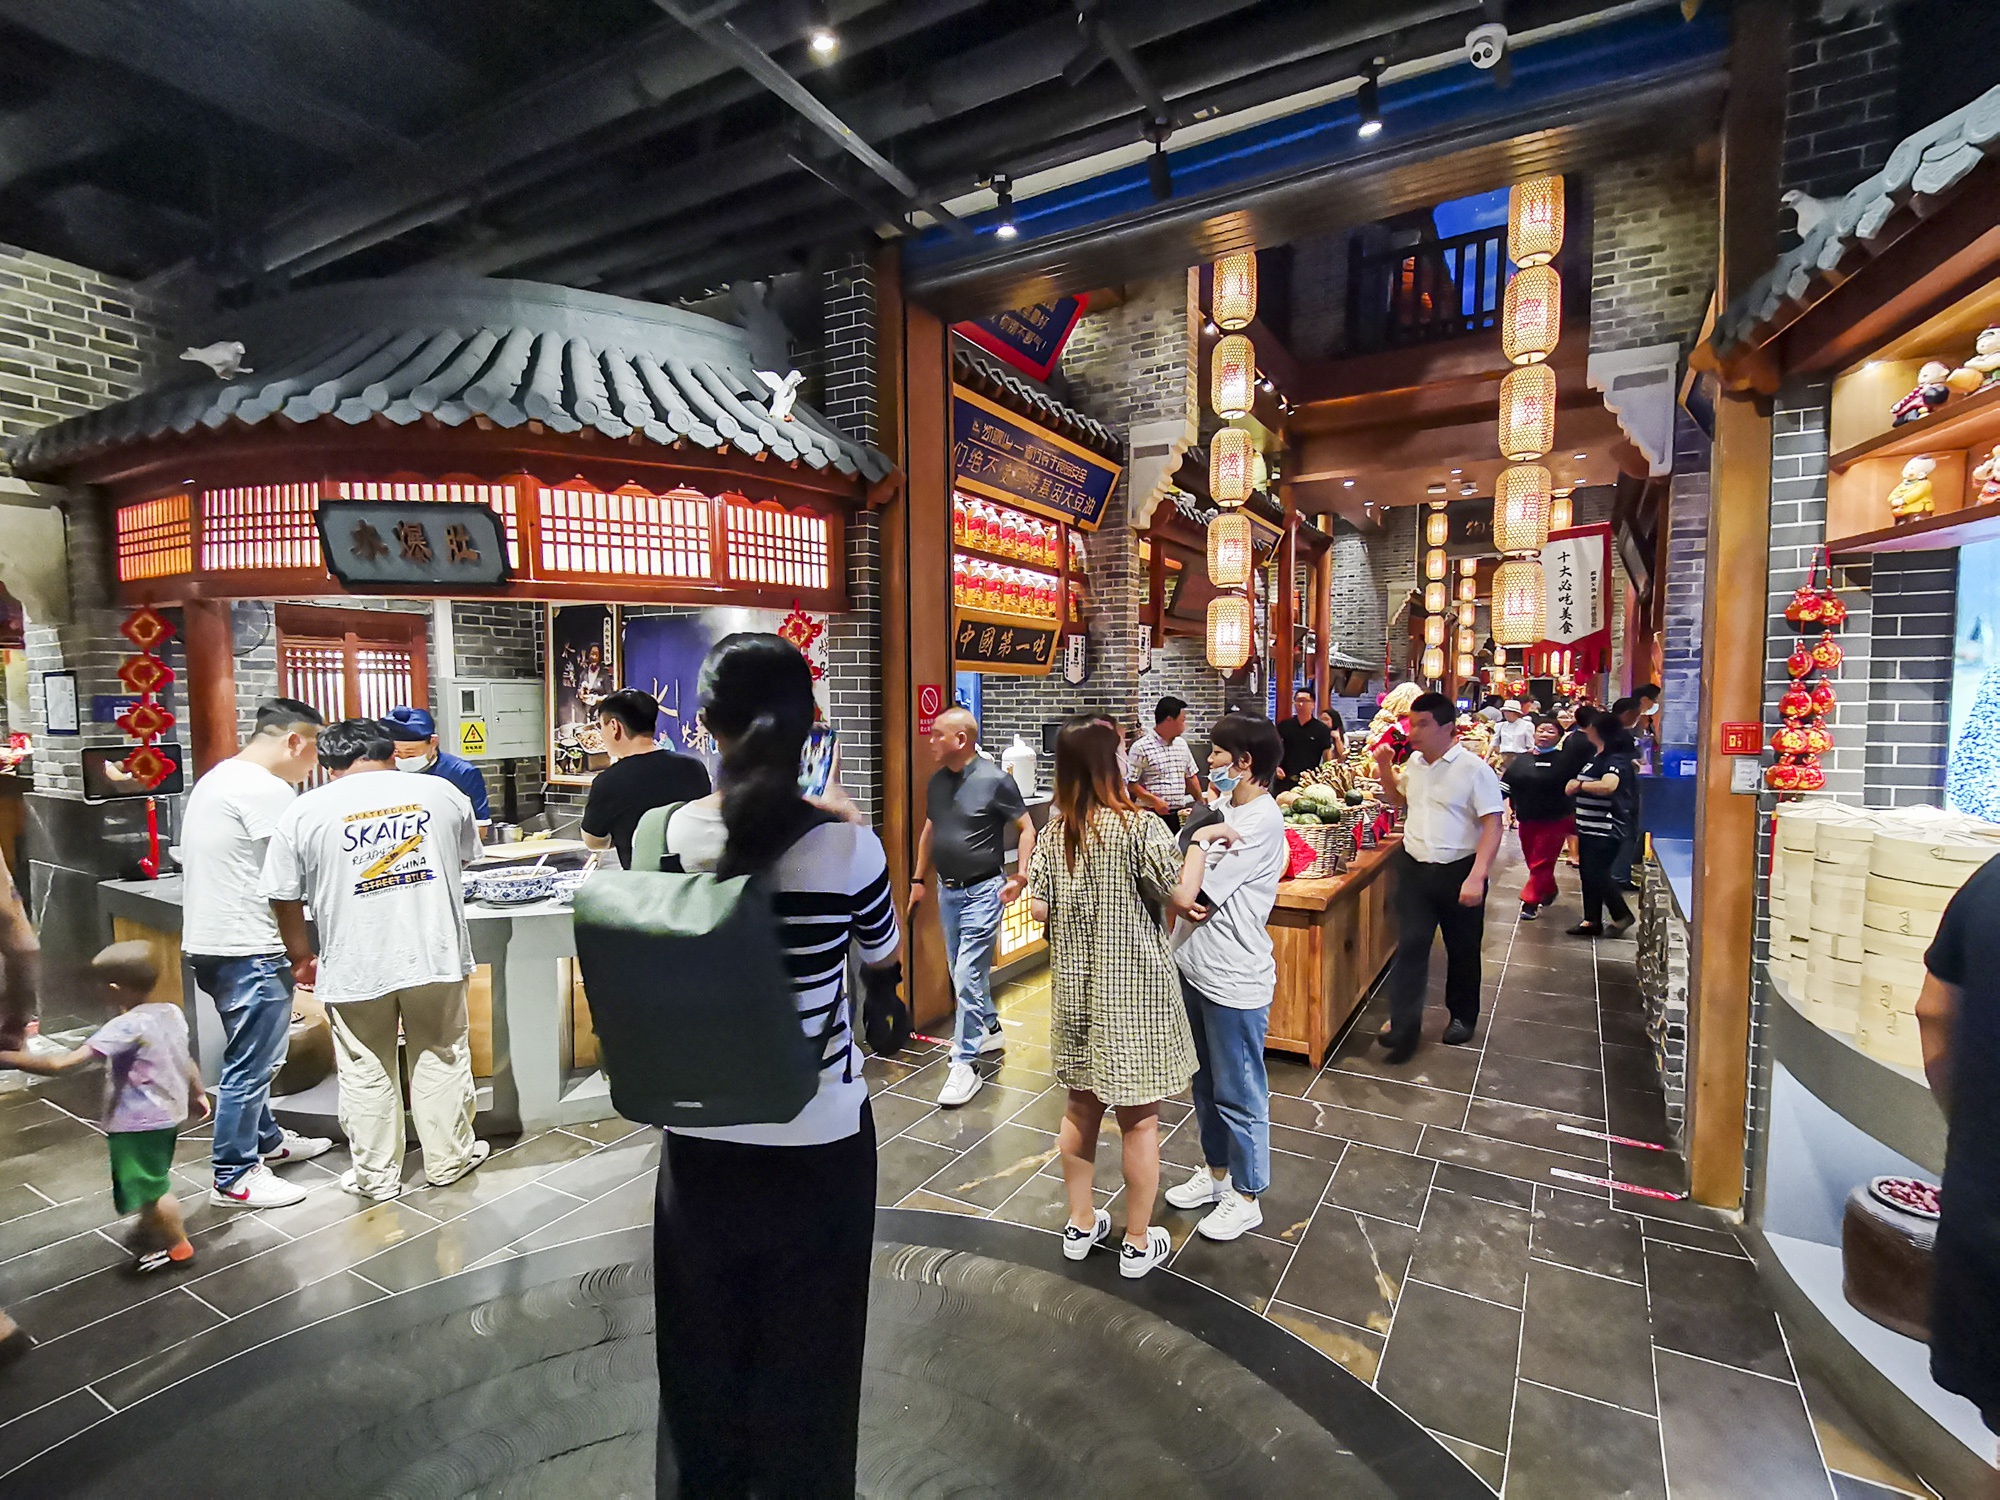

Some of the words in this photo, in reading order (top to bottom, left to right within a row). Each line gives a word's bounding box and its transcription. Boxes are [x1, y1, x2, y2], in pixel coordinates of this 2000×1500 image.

[1557, 551, 1574, 635] 十大必吃美食
[959, 624, 1047, 662] 中國第一吃
[342, 809, 431, 853] SKATER
[394, 856, 427, 872] CHINA
[361, 875, 400, 892] STREET
